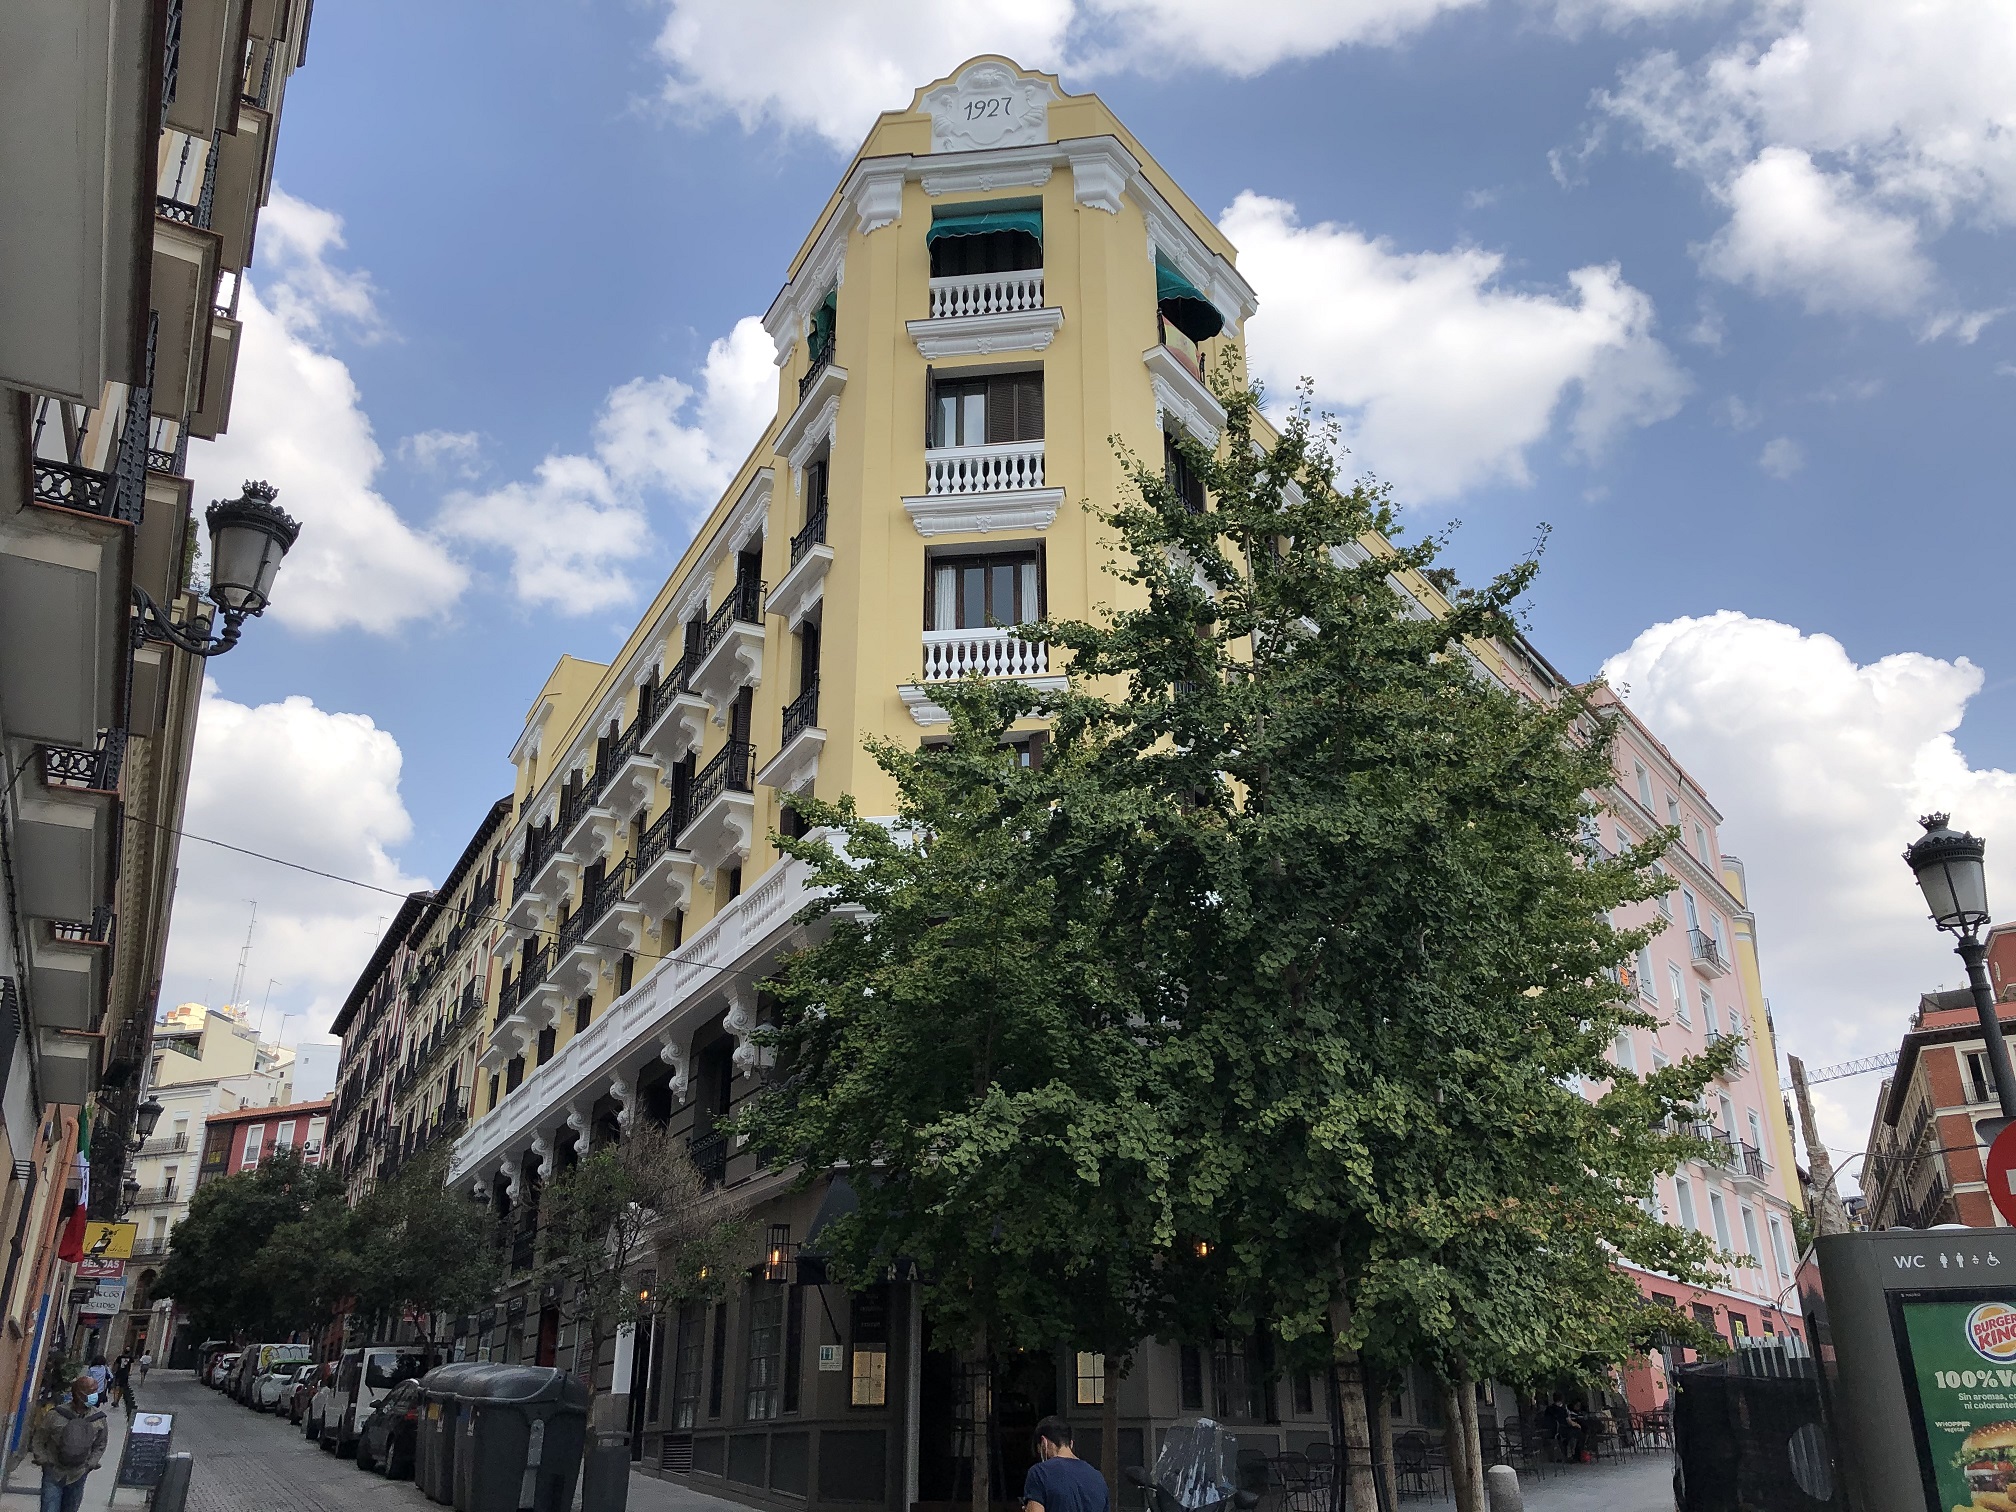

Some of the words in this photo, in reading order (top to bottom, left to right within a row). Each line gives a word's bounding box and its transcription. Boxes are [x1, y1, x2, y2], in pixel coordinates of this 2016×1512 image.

[963, 96, 1013, 121] 1927
[81, 1259, 120, 1269] BEDAS
[1893, 1255, 1926, 1269] WC
[1958, 1392, 1972, 1401] Sin
[1973, 1393, 2007, 1401] aromas,
